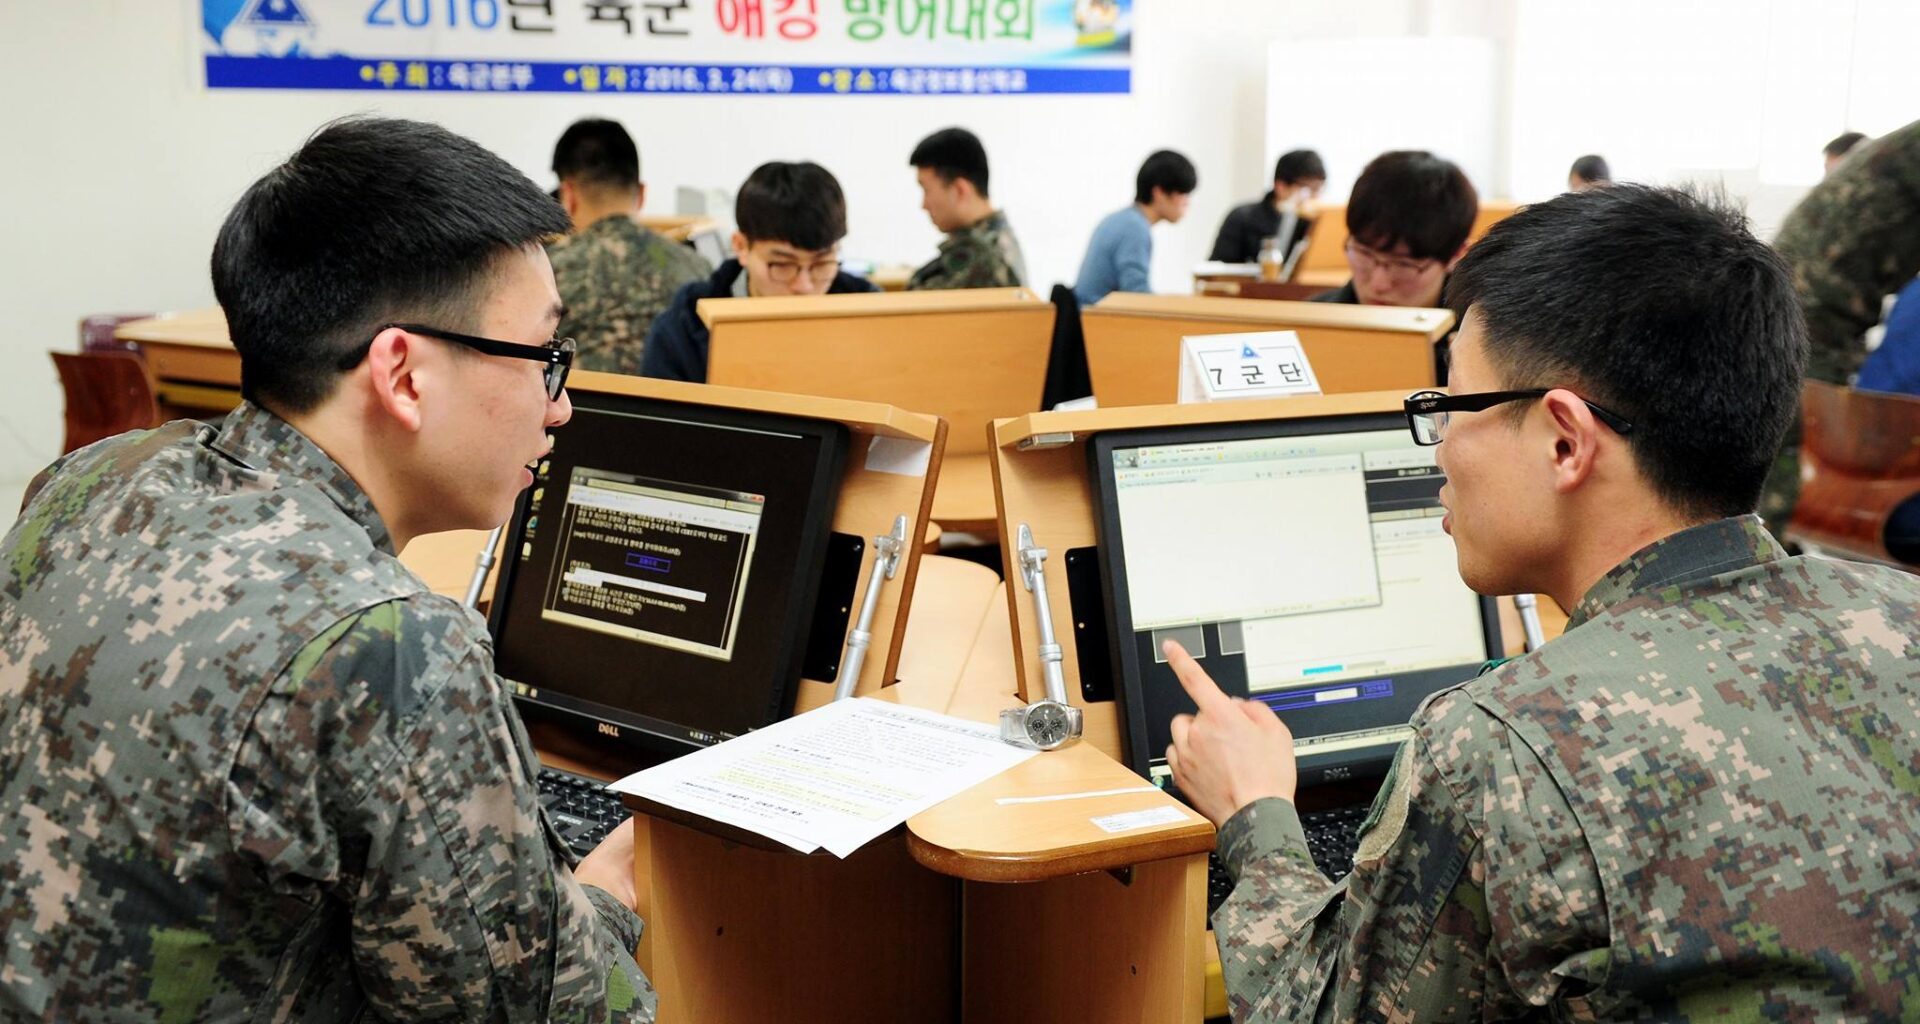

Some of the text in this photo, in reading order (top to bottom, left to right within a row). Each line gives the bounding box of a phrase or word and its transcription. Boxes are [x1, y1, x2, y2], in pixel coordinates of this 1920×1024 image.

[1209, 361, 1303, 385] 7 군 단
[598, 722, 620, 737] DELL
